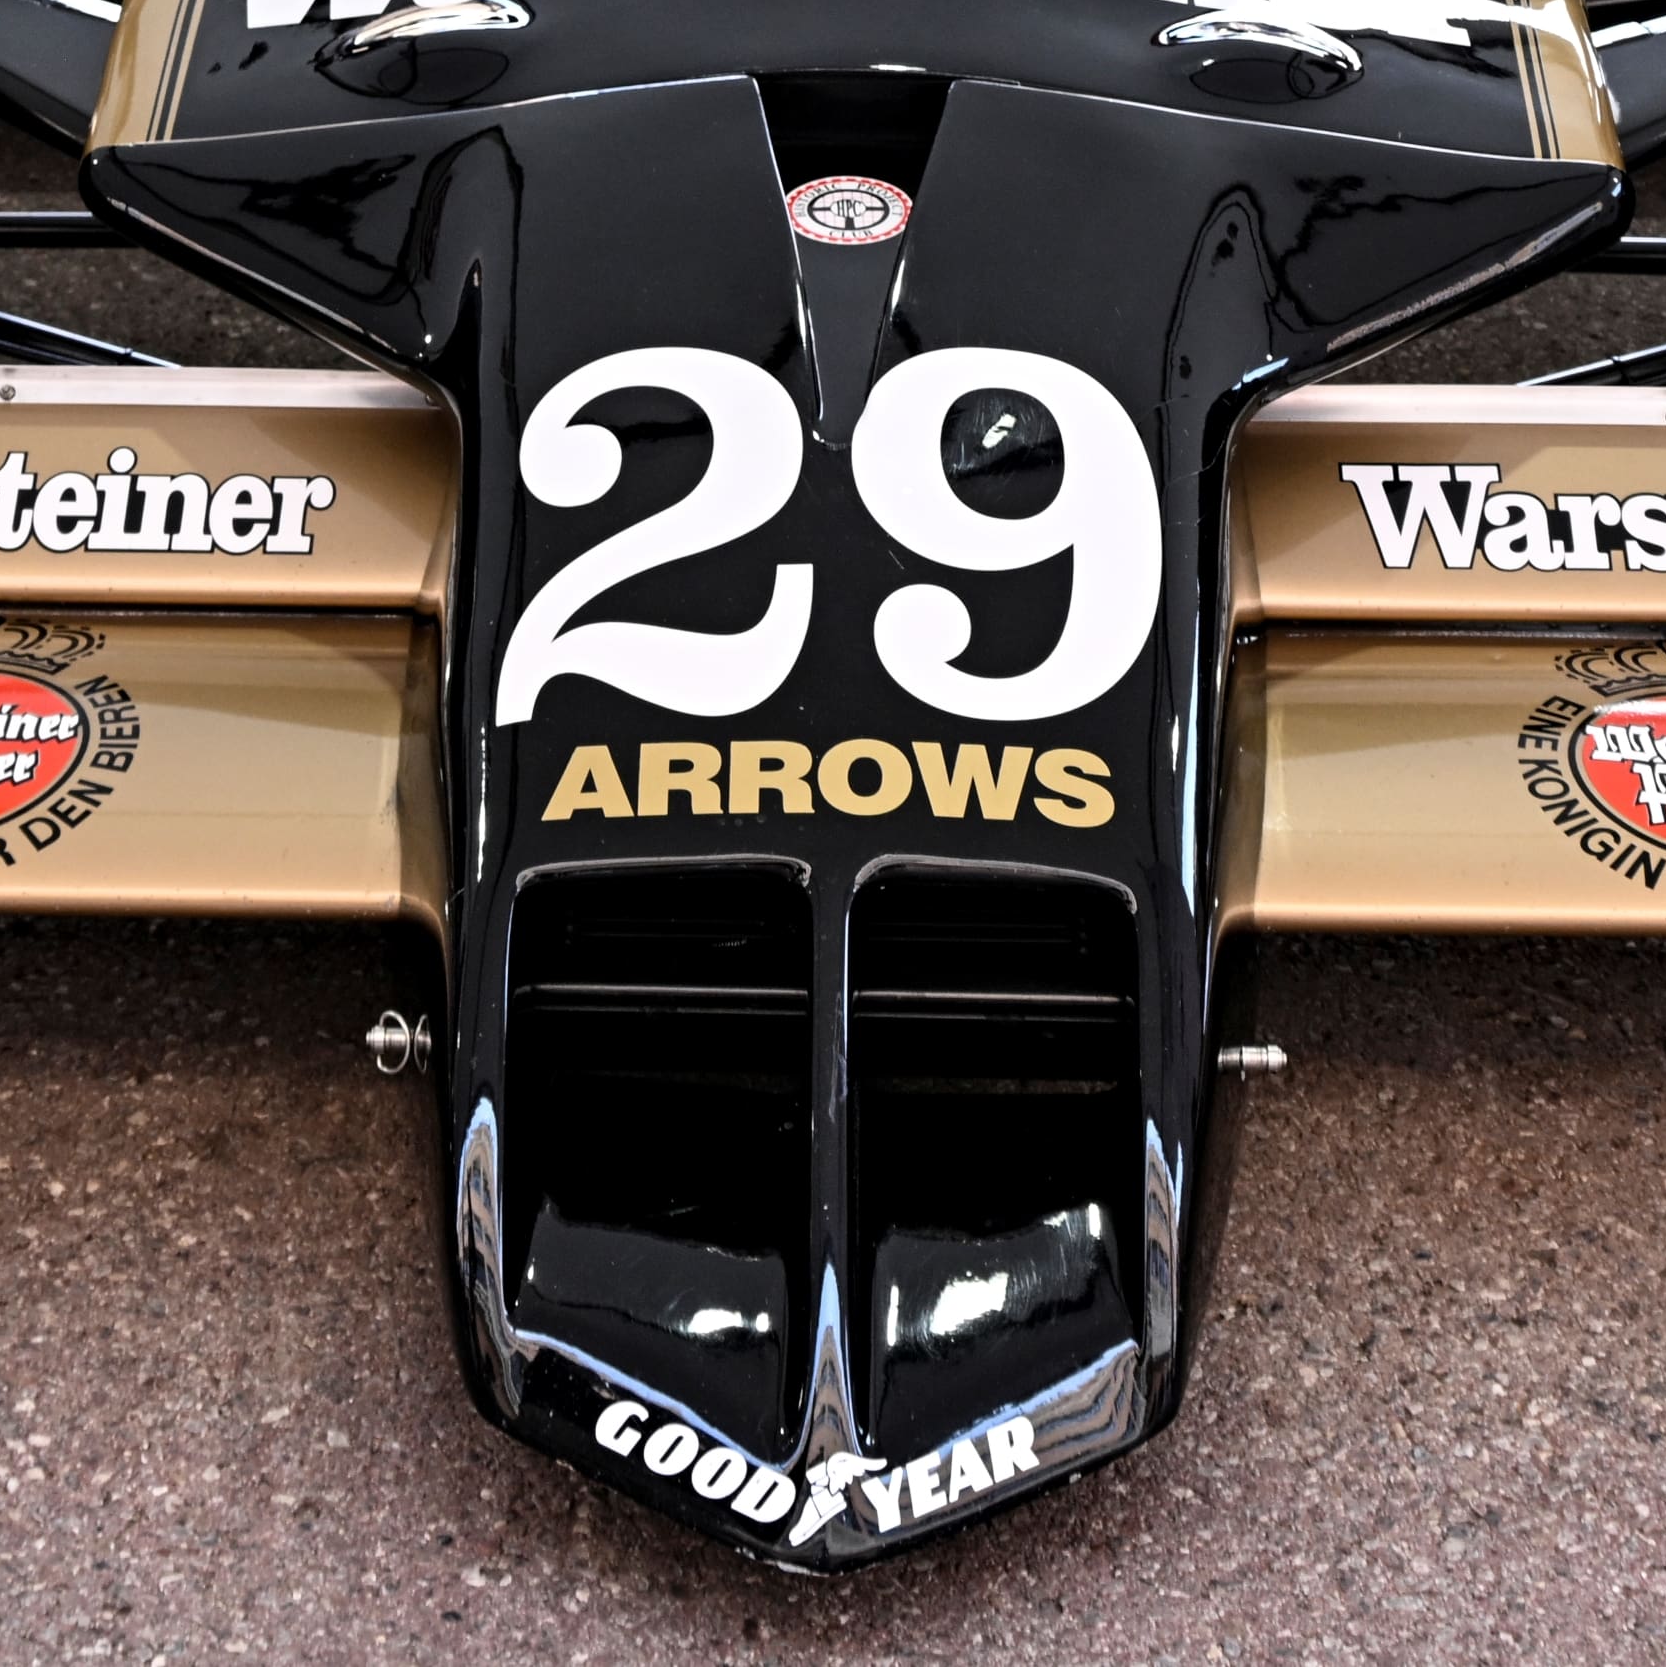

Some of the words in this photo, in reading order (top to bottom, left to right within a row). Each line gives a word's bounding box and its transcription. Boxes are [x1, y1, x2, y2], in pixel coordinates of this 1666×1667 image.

[495, 346, 1163, 728] 29
[19, 779, 115, 852] DEN
[74, 674, 141, 773] BIEREN
[541, 738, 1116, 828] ARROWS
[1517, 695, 1587, 752] EINE
